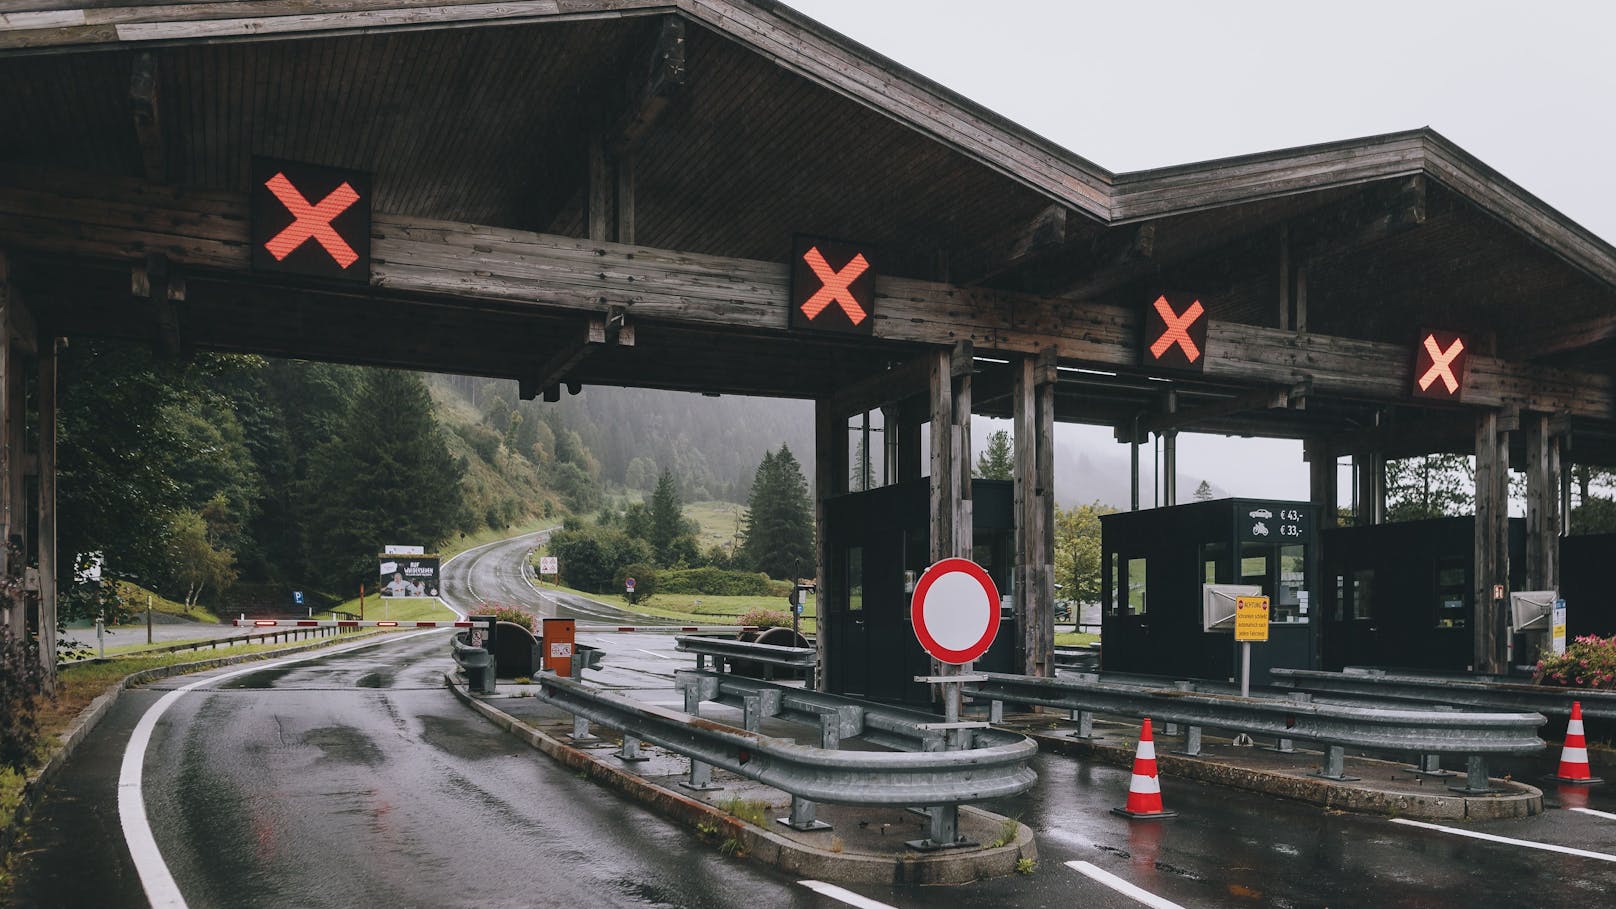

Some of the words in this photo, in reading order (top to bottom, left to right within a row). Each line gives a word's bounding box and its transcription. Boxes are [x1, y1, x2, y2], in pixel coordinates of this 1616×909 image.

[1280, 510, 1286, 520] €
[1287, 510, 1303, 522] 43,-
[1280, 525, 1286, 535] €
[1287, 525, 1303, 537] 33,-
[295, 591, 301, 601] P
[1244, 601, 1262, 609] ACHTUNG
